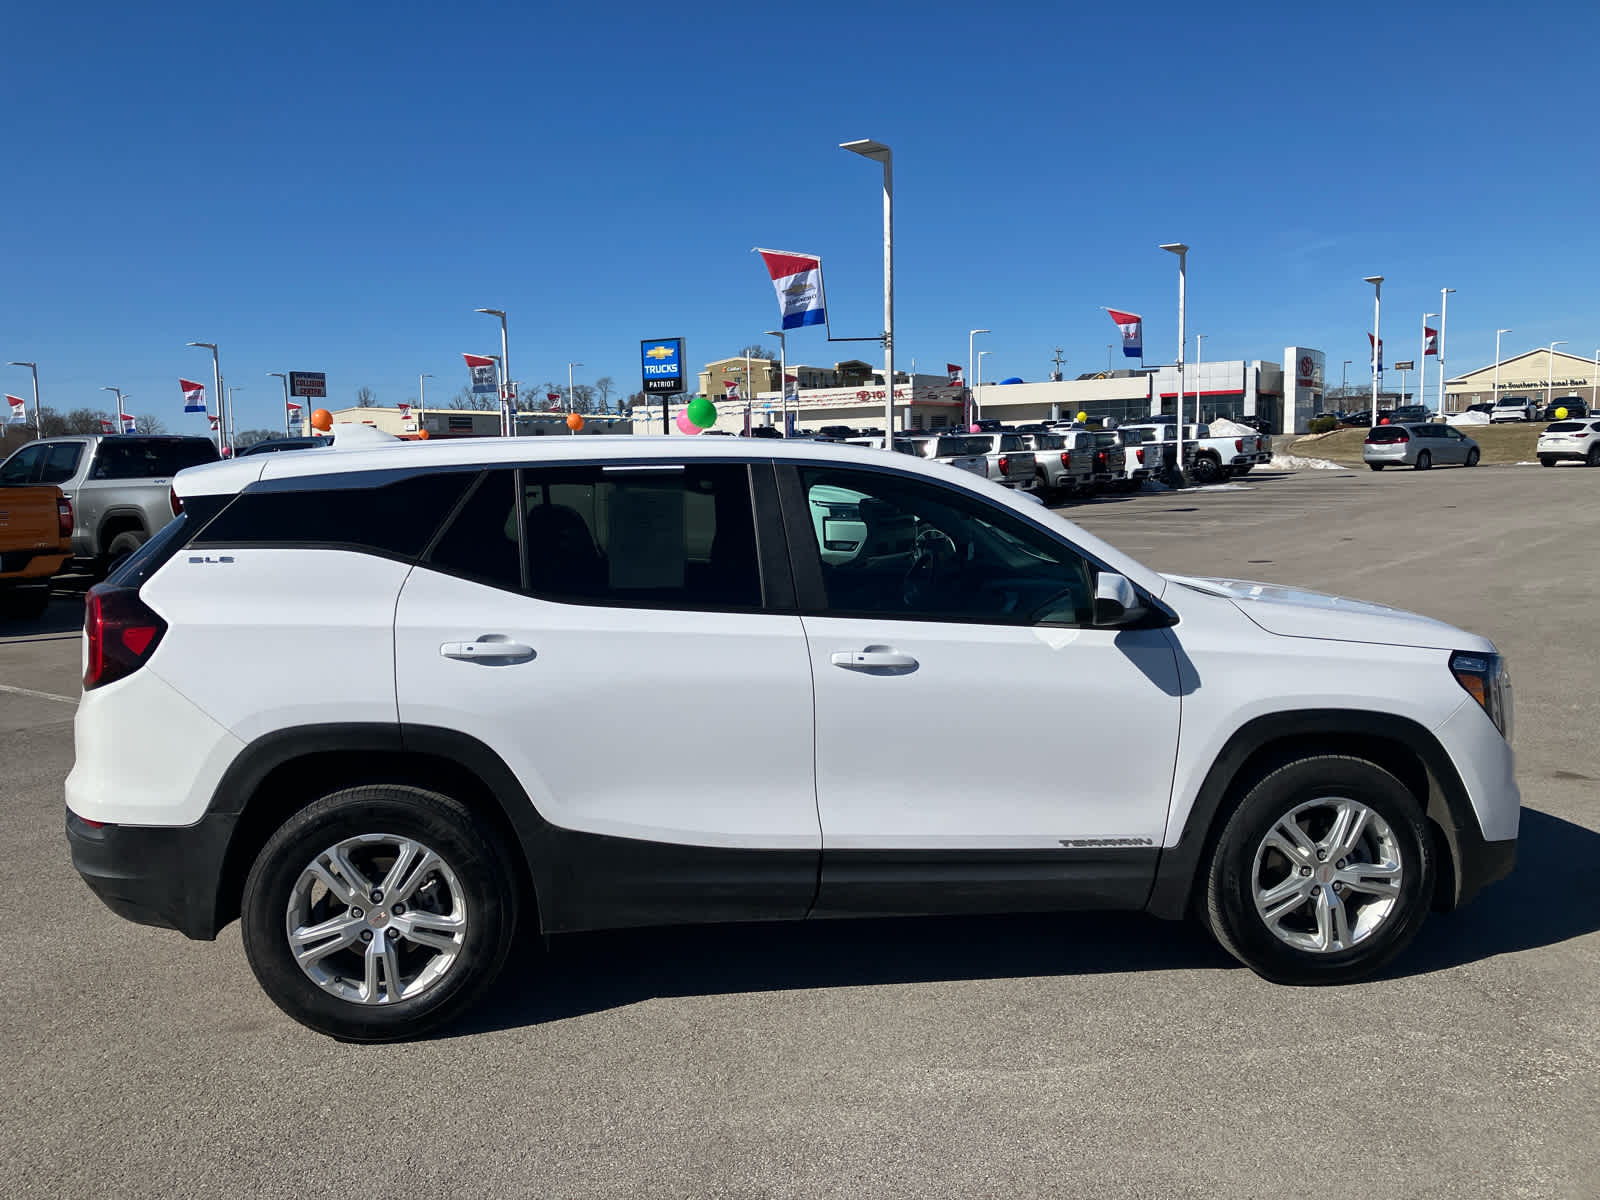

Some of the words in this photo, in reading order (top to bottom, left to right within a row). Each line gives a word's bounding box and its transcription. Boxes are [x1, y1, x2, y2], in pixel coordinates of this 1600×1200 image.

[644, 363, 678, 374] TRUCKS
[295, 379, 325, 387] COLLISION
[649, 380, 675, 388] PATRIOT
[1539, 379, 1568, 387] Naional
[870, 388, 905, 400] TOYTA
[189, 556, 234, 564] SLE
[1059, 838, 1153, 847] TERRAIN
